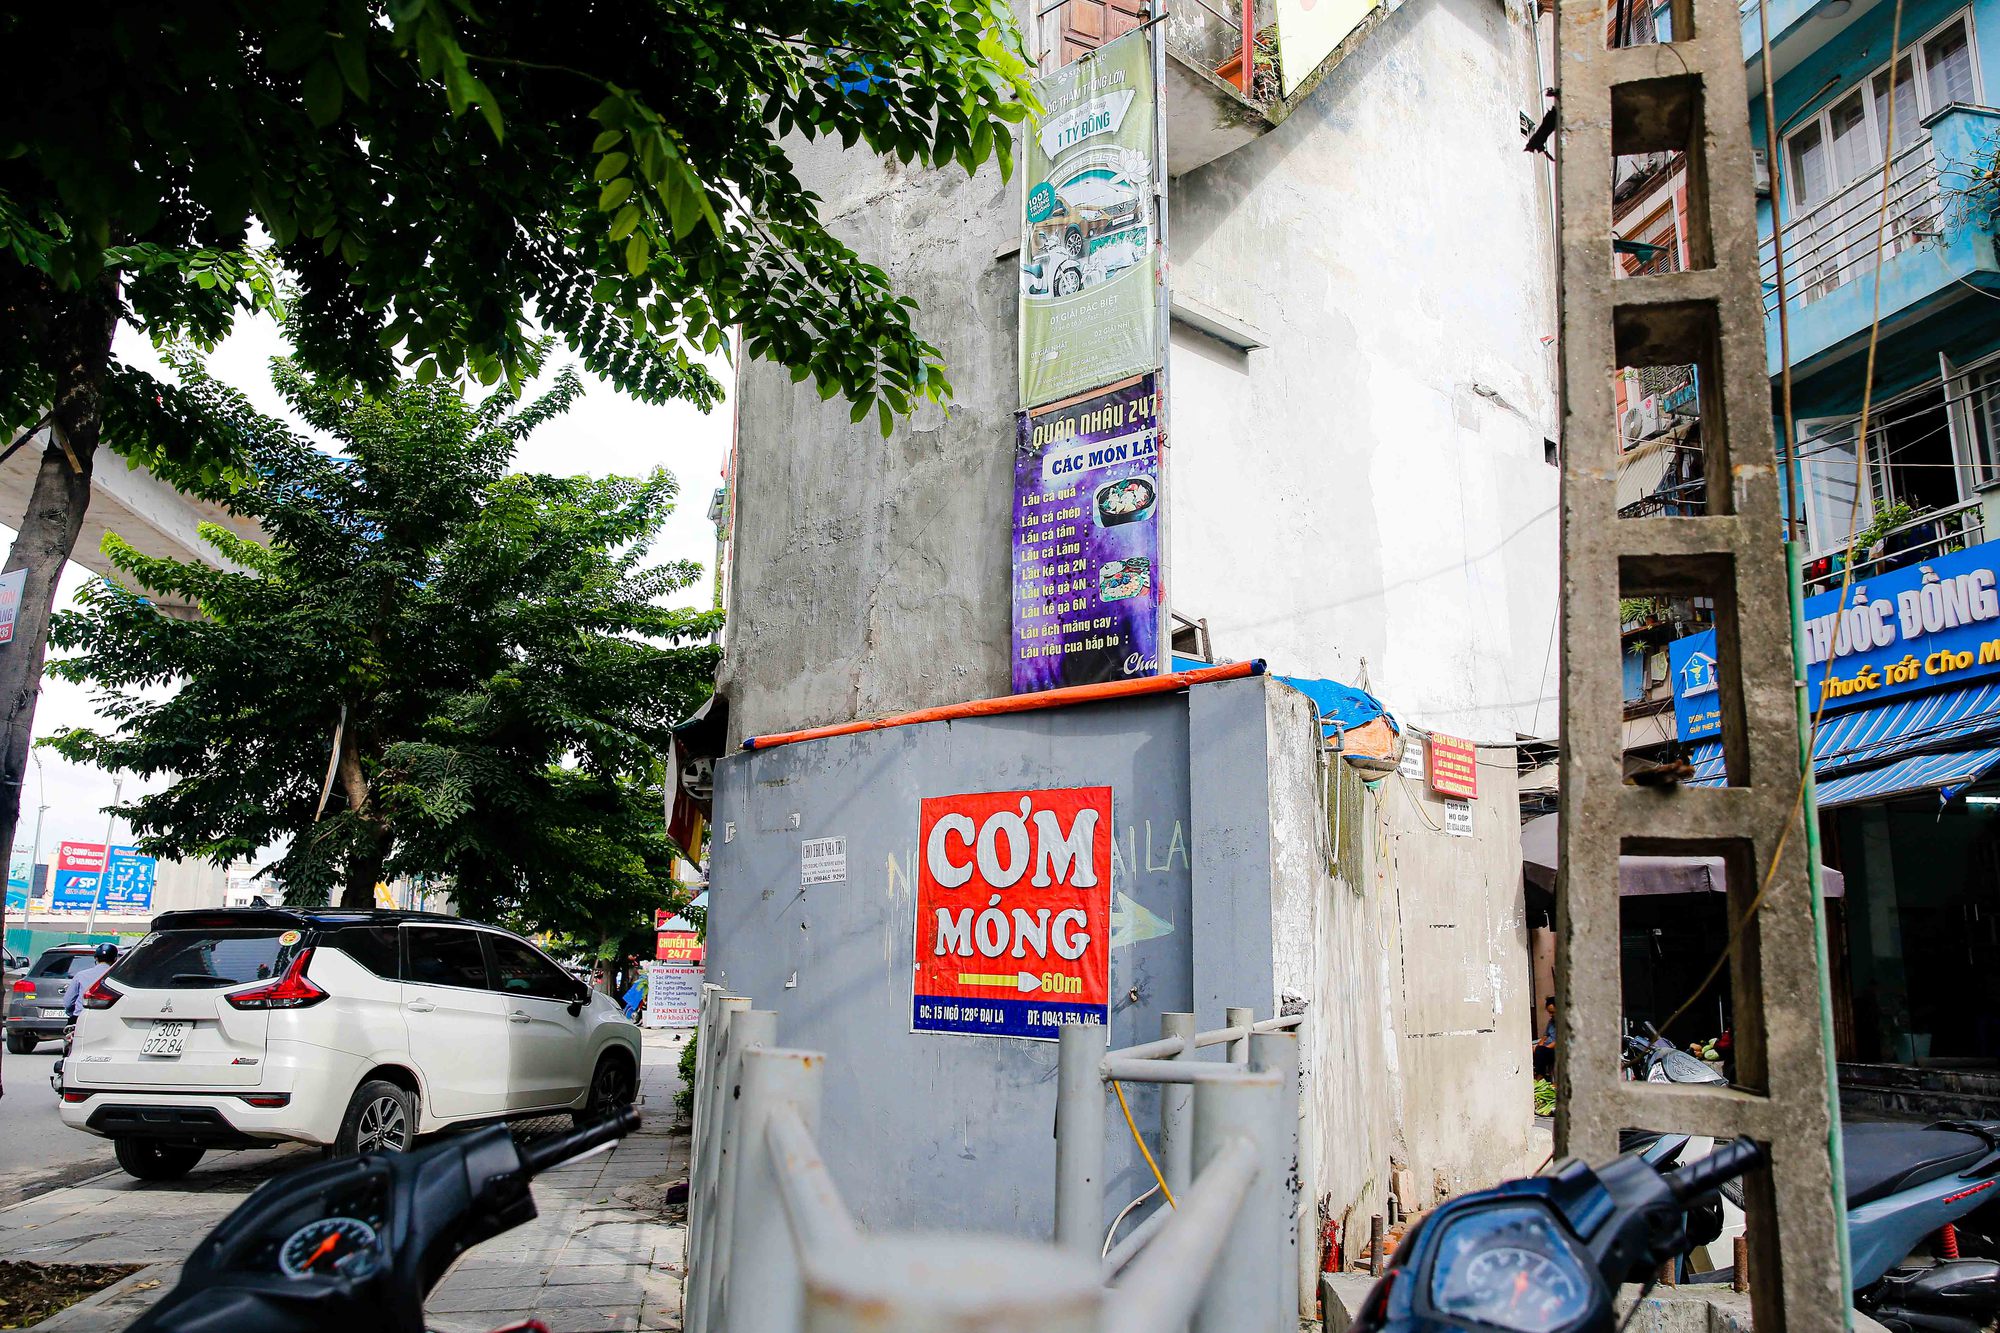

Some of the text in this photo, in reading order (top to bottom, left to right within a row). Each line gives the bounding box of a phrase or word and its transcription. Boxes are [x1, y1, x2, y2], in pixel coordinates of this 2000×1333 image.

[1057, 132, 1062, 147] 1
[1081, 112, 1110, 138] ĐỒNG
[1029, 189, 1049, 207] 100%
[1033, 394, 1157, 447] QUÁN NHẬU 247
[1052, 454, 1084, 475] CÁC
[1088, 444, 1127, 467] MÓN
[1022, 492, 1040, 507] Lẩu
[1021, 512, 1039, 528] Lẩu
[1056, 506, 1081, 521] chép
[1021, 530, 1039, 545] Lẩu
[1056, 542, 1080, 556] Lăng
[1057, 562, 1070, 576] gà
[1073, 558, 1087, 572] 2N
[1057, 581, 1070, 595] gà
[1073, 578, 1087, 591] 4N
[1057, 601, 1070, 615] gà
[1073, 597, 1087, 611] 6N
[1803, 566, 2000, 665] THUỐC ĐỒNG
[1021, 624, 1039, 640] Lẩu
[1041, 622, 1060, 637] ếch
[1062, 619, 1091, 634] măng
[1021, 643, 1039, 659] Lẩu
[1064, 641, 1083, 653] cua
[1085, 634, 1104, 650] bắp
[1819, 665, 1882, 700] Thuốc
[1883, 653, 1921, 686] Tốt
[1924, 649, 1974, 676] Cho
[927, 796, 1099, 889] CƠM
[934, 893, 1091, 960] MÓNG
[668, 949, 692, 959] 24/7
[1041, 972, 1082, 994] 60m
[934, 1006, 943, 1019] 15
[943, 1004, 959, 1020] NGÕ
[980, 1009, 993, 1025] ĐẠI
[994, 1009, 1004, 1023] LA
[1027, 1009, 1040, 1026] ĐT:
[158, 1022, 183, 1037] 30G
[143, 1038, 184, 1053] 372.84
